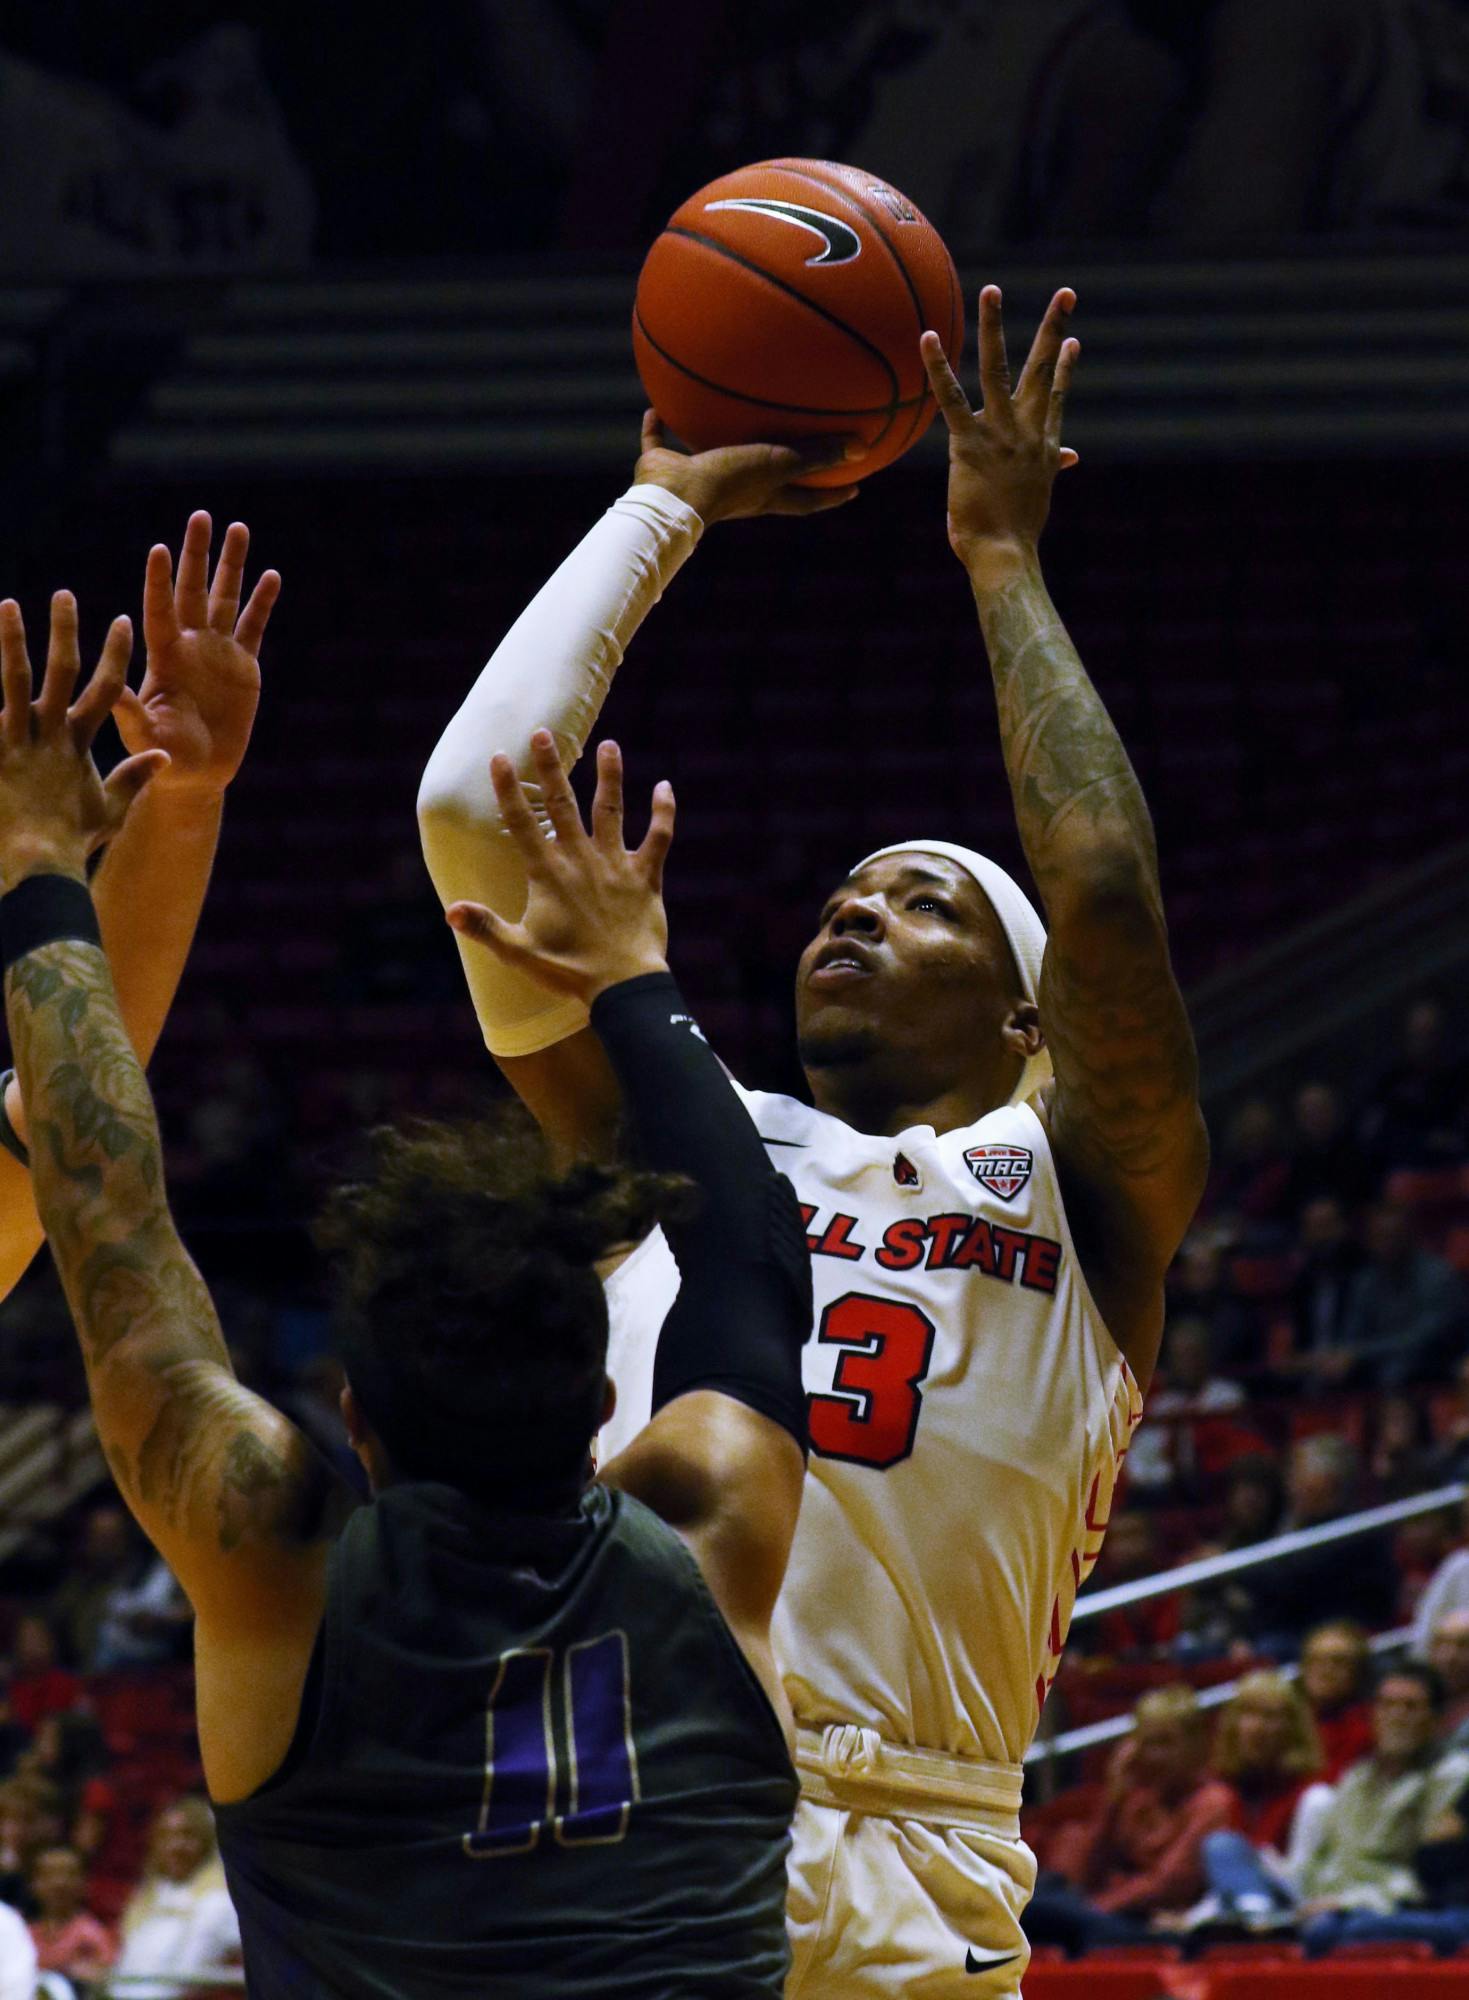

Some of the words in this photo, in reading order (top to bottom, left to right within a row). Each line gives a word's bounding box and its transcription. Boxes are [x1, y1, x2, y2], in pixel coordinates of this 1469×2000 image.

[972, 1160, 1030, 1175] MAC
[874, 1213, 1061, 1294] STATE
[807, 1291, 936, 1470] 3
[463, 1629, 640, 1858] 11
